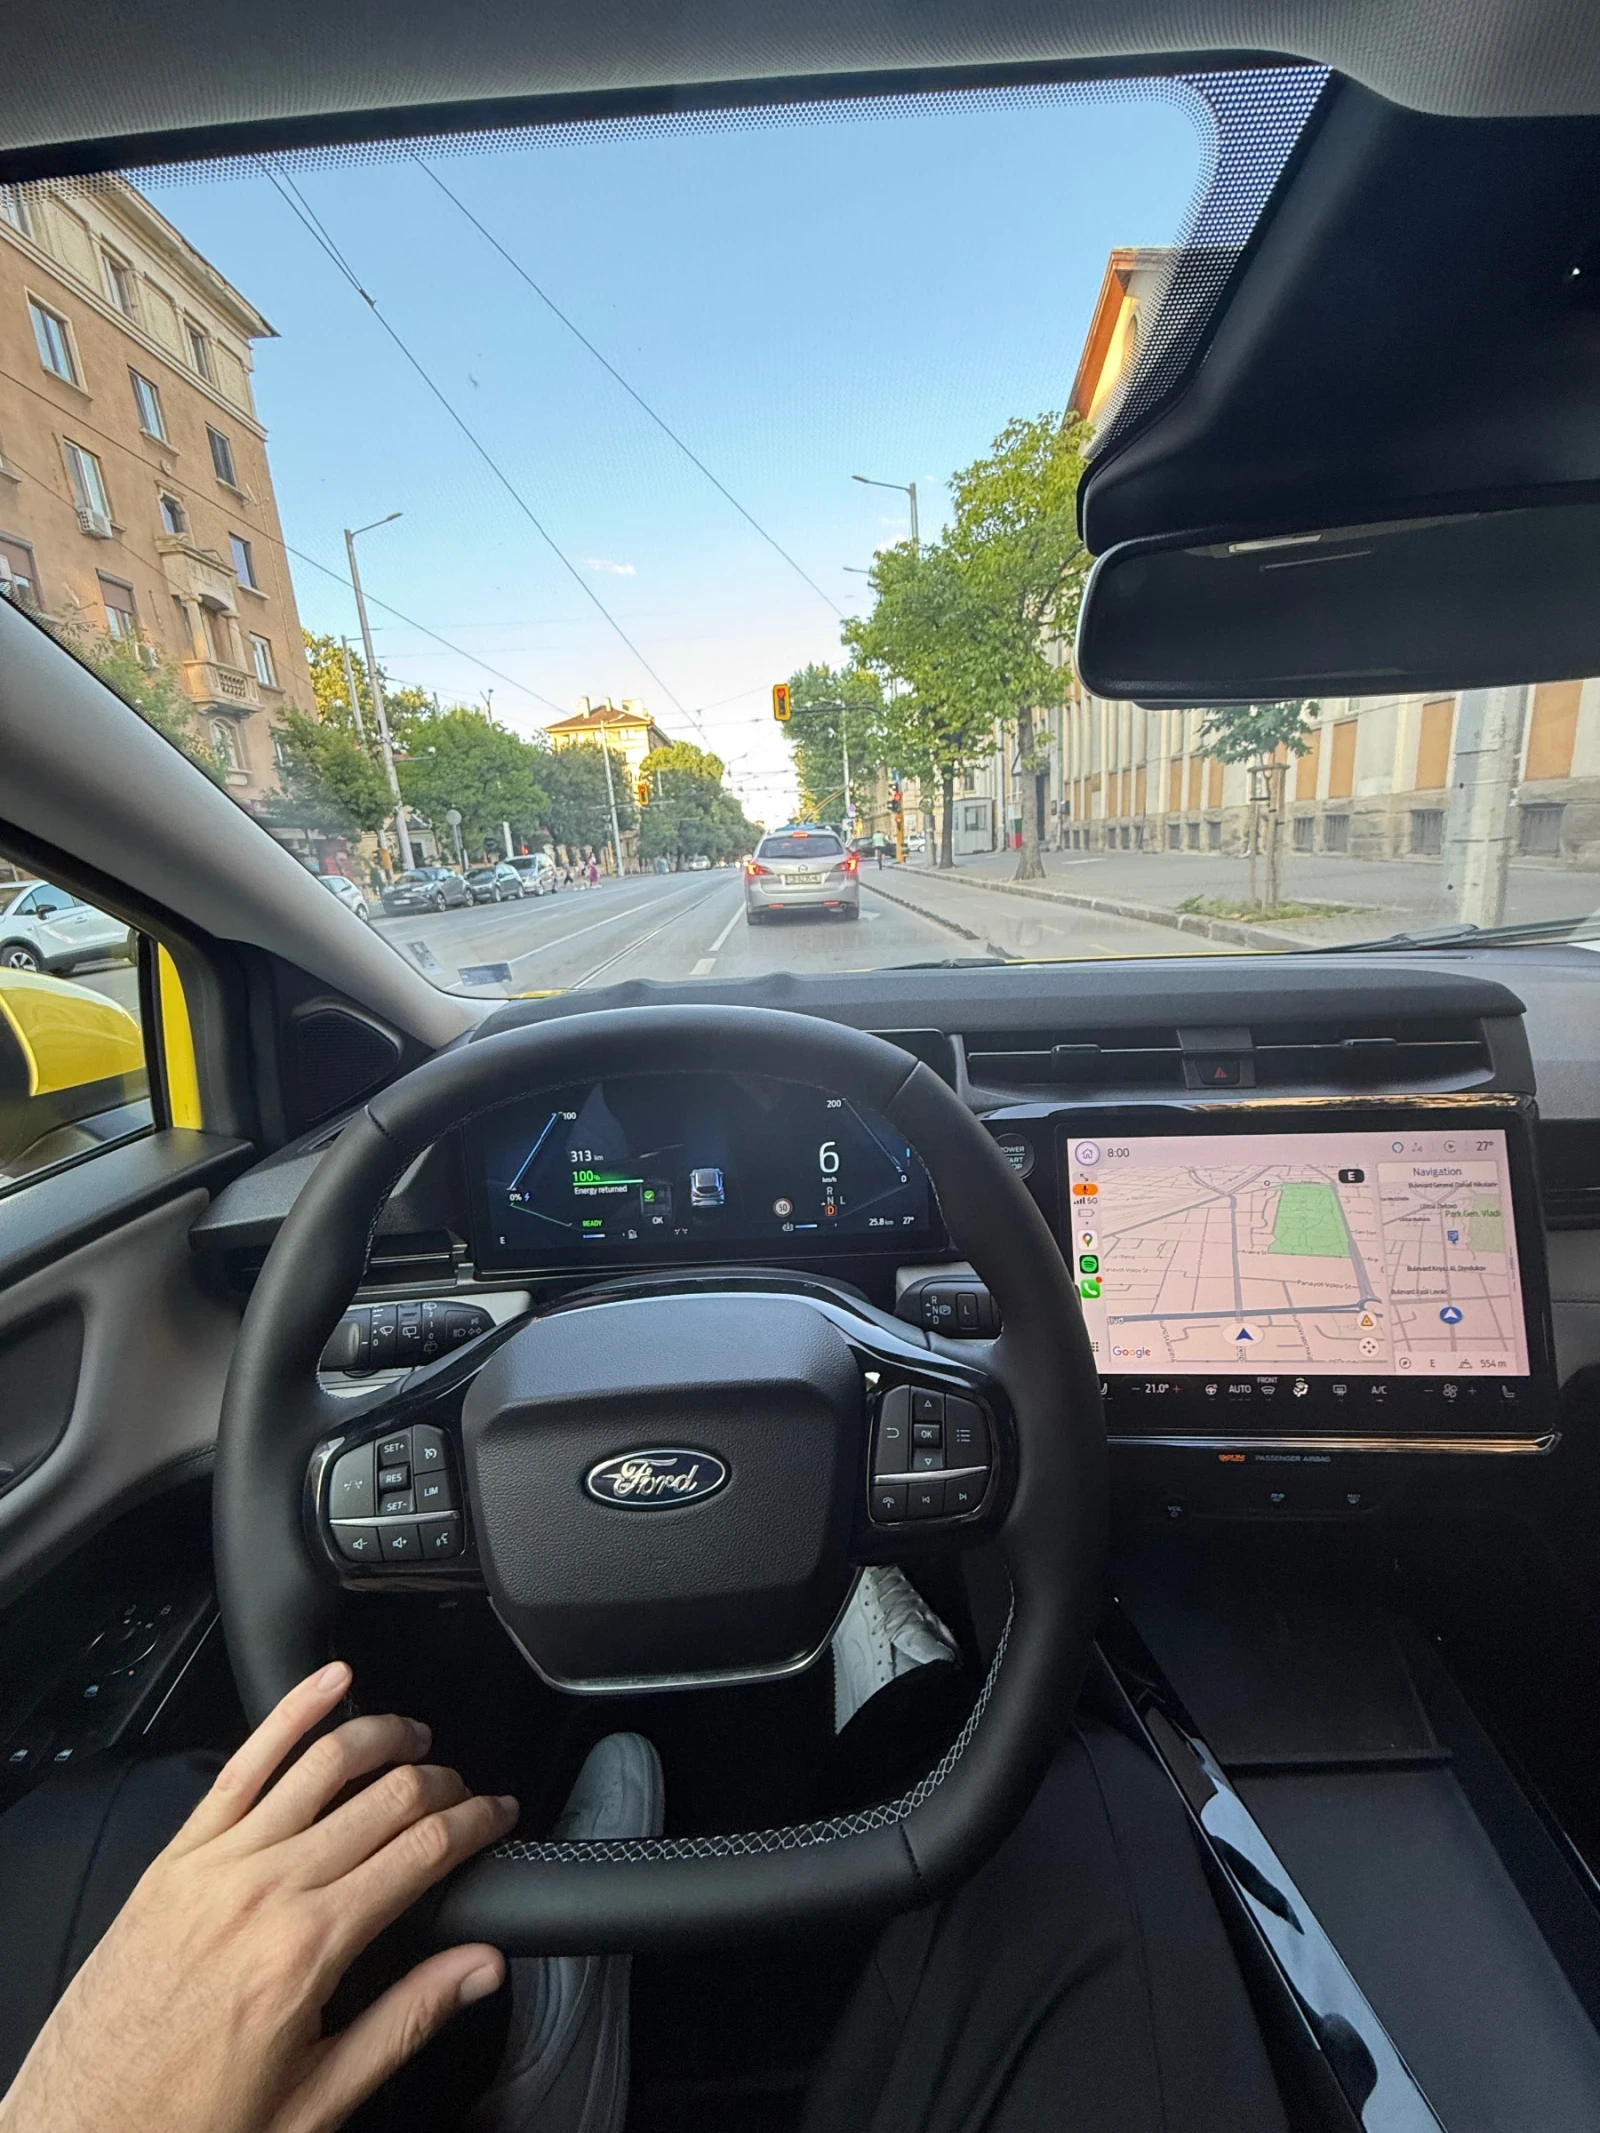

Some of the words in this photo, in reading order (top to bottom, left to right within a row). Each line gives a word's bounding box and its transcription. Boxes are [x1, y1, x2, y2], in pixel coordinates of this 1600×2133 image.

[826, 1100, 842, 1108] 200
[563, 1112, 577, 1120] 100
[1476, 1141, 1494, 1151] 27°
[570, 1150, 592, 1163] 313
[819, 1141, 840, 1173] 6
[1107, 1148, 1130, 1158] 8:00
[1347, 1172, 1356, 1181] E
[1413, 1167, 1462, 1178] Navigation
[901, 1175, 907, 1183] 0
[574, 1186, 598, 1196] Energy
[598, 1185, 628, 1194] returned
[826, 1186, 833, 1195] R
[509, 1193, 522, 1201] 0%
[827, 1196, 834, 1205] N
[840, 1196, 846, 1205] L
[1087, 1197, 1098, 1205] 5G
[778, 1203, 788, 1212] 50
[827, 1206, 835, 1215] D
[1445, 1210, 1461, 1218] Park
[1463, 1210, 1480, 1218] Gen.
[652, 1216, 664, 1225] OK
[869, 1218, 885, 1226] 25.8
[902, 1217, 915, 1225] 27°
[500, 1236, 506, 1245] E
[1297, 1279, 1324, 1288] Panayot
[931, 1295, 938, 1305] R
[932, 1305, 939, 1315] N
[963, 1305, 970, 1315] L
[932, 1315, 940, 1325] D
[373, 1339, 379, 1347] 0
[1112, 1346, 1151, 1359] Google
[1430, 1359, 1436, 1368] E
[1480, 1360, 1496, 1368] 554
[1145, 1383, 1169, 1394] 21.0°
[1228, 1384, 1252, 1394] AUTO
[1371, 1385, 1388, 1394] A/C
[920, 1430, 933, 1439] OK
[383, 1442, 405, 1453] SET+
[1255, 1454, 1301, 1462] PASSENGER
[1303, 1455, 1331, 1463] AIRBAG
[385, 1473, 402, 1483] RES
[601, 1457, 700, 1498] Ford
[424, 1486, 439, 1497] LIM
[386, 1501, 407, 1512] SET-
